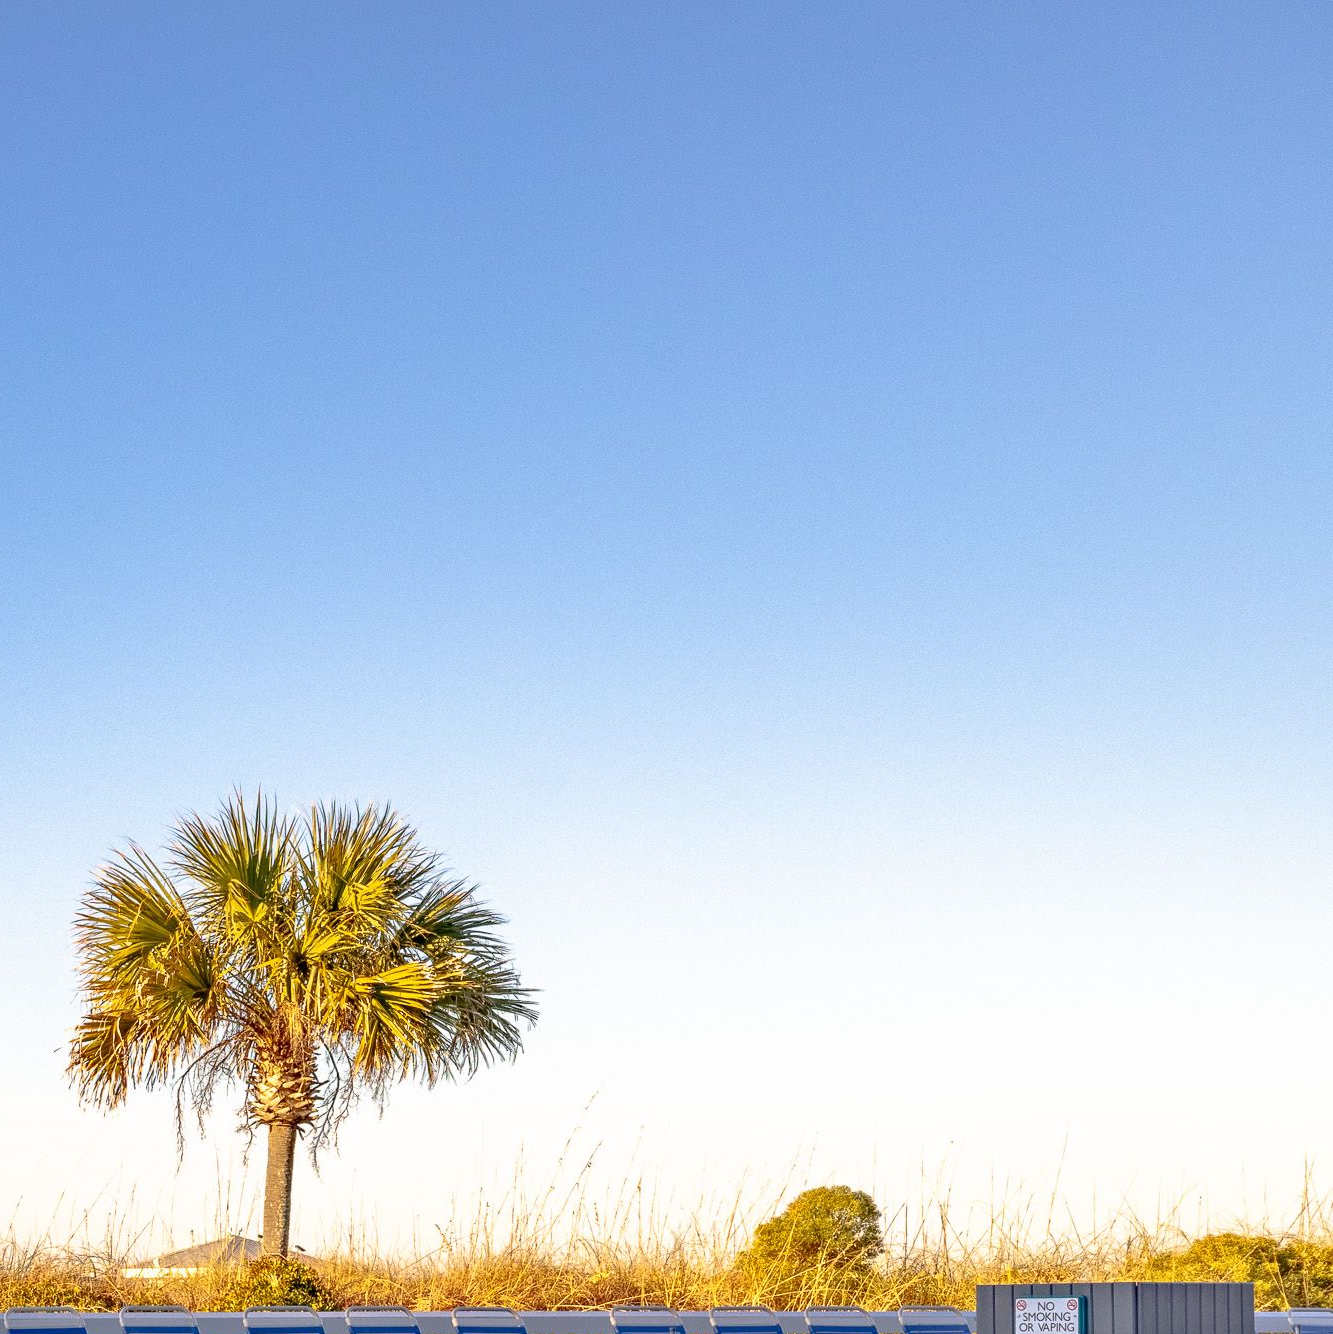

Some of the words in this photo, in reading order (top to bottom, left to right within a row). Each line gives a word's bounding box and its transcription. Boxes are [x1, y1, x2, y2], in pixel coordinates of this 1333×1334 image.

[1038, 1301, 1055, 1311] NO
[1023, 1312, 1071, 1322] SMOKING
[1019, 1322, 1034, 1332] OR
[1038, 1322, 1075, 1332] VAPING
